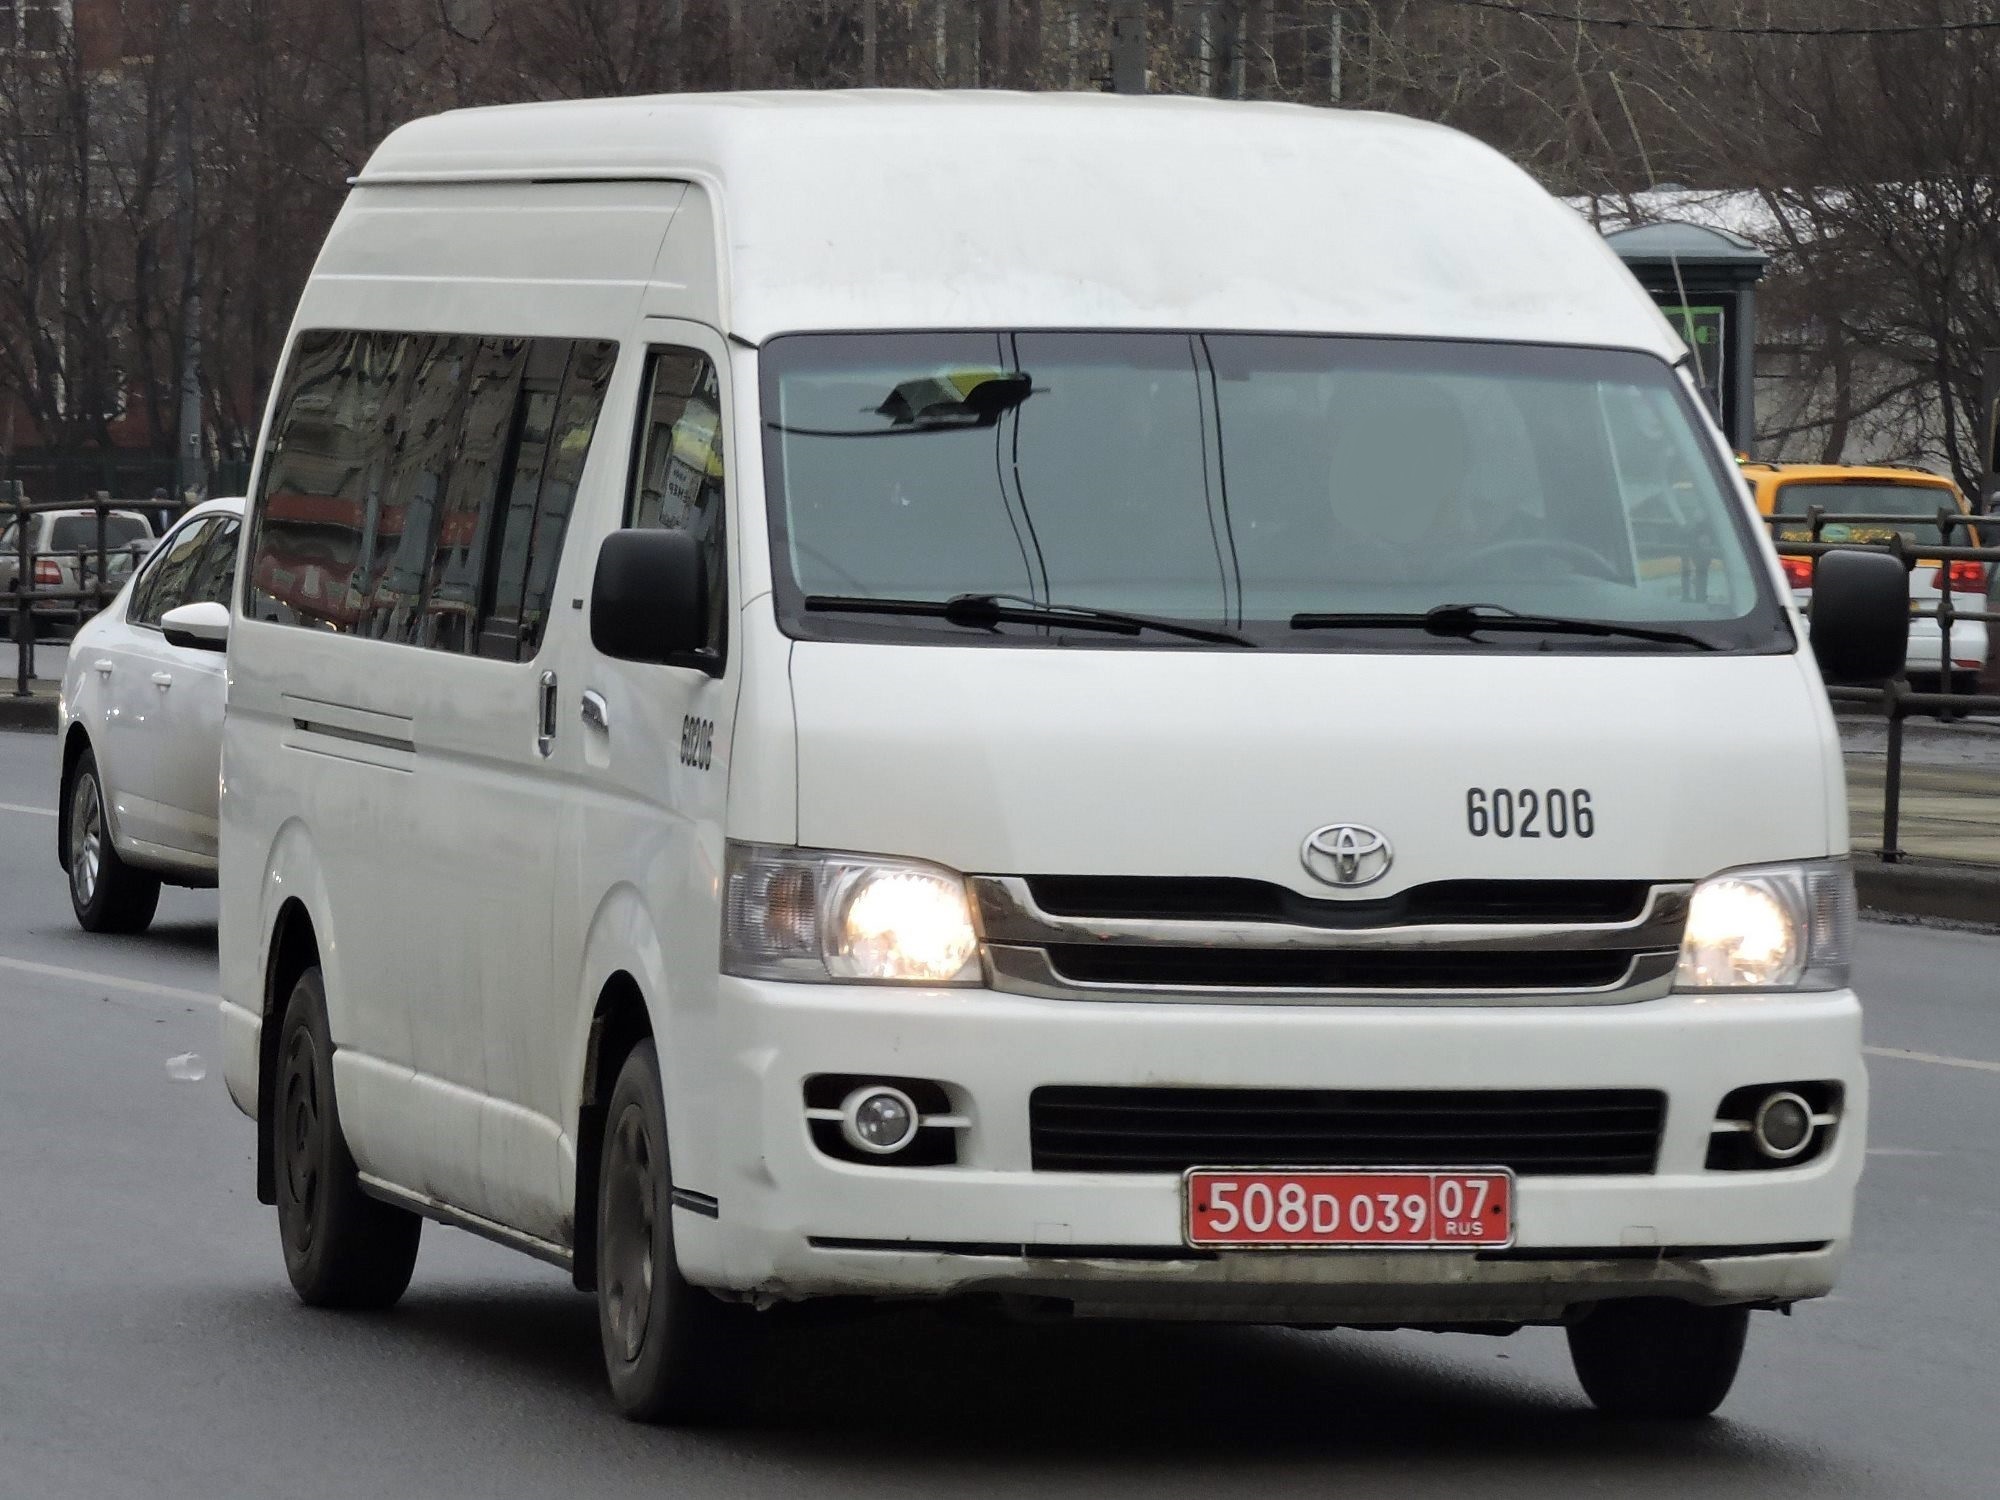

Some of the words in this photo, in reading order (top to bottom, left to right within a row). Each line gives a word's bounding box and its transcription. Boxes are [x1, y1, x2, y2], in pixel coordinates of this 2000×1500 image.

[680, 714, 714, 771] 60206
[1466, 787, 1595, 838] 60206
[1438, 1180, 1489, 1219] 07
[1445, 1221, 1484, 1236] RUS
